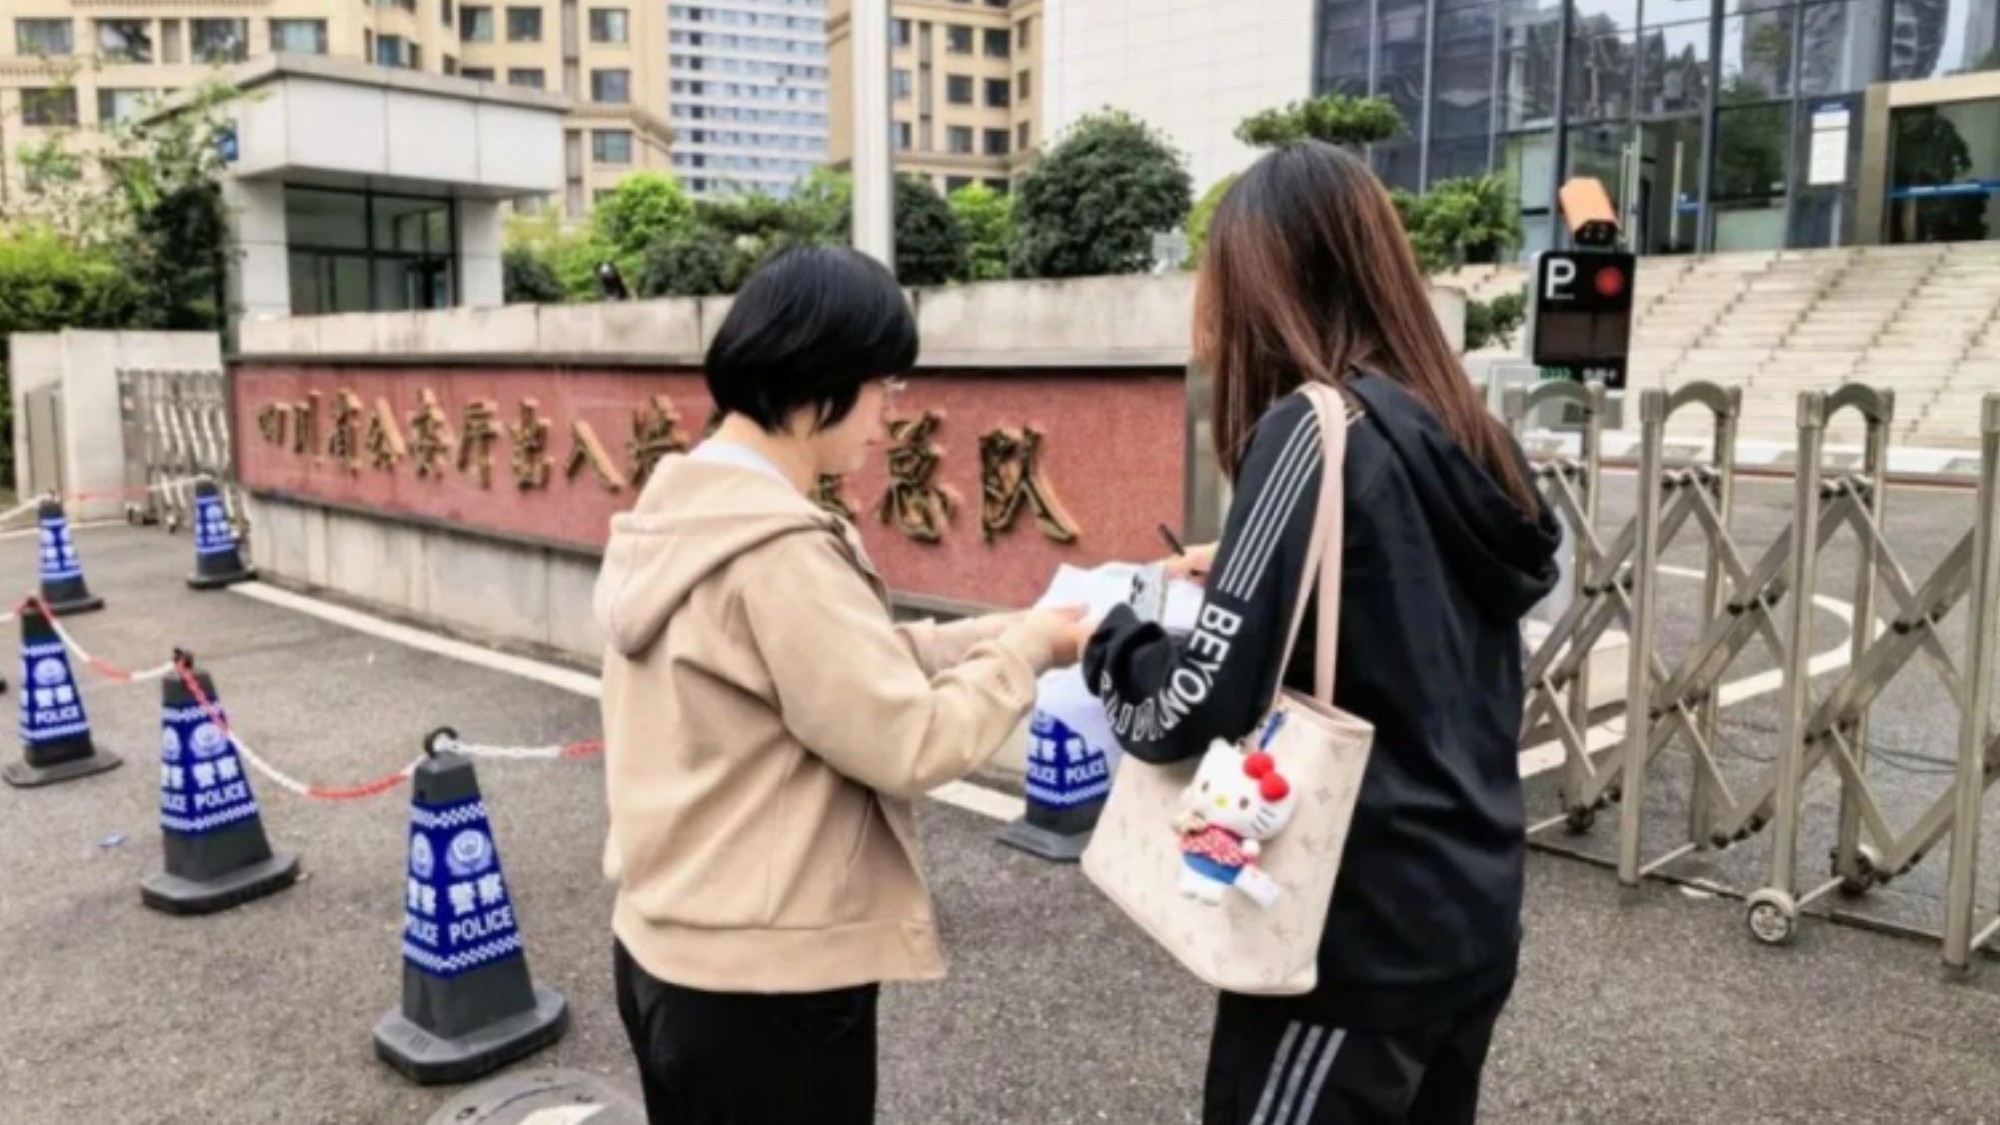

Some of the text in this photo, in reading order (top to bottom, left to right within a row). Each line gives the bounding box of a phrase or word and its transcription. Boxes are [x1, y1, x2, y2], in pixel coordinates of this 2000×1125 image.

[1545, 258, 1577, 299] P
[1066, 757, 1106, 784] POLICE
[194, 780, 247, 811] POLICE
[449, 905, 513, 945] POLICE
